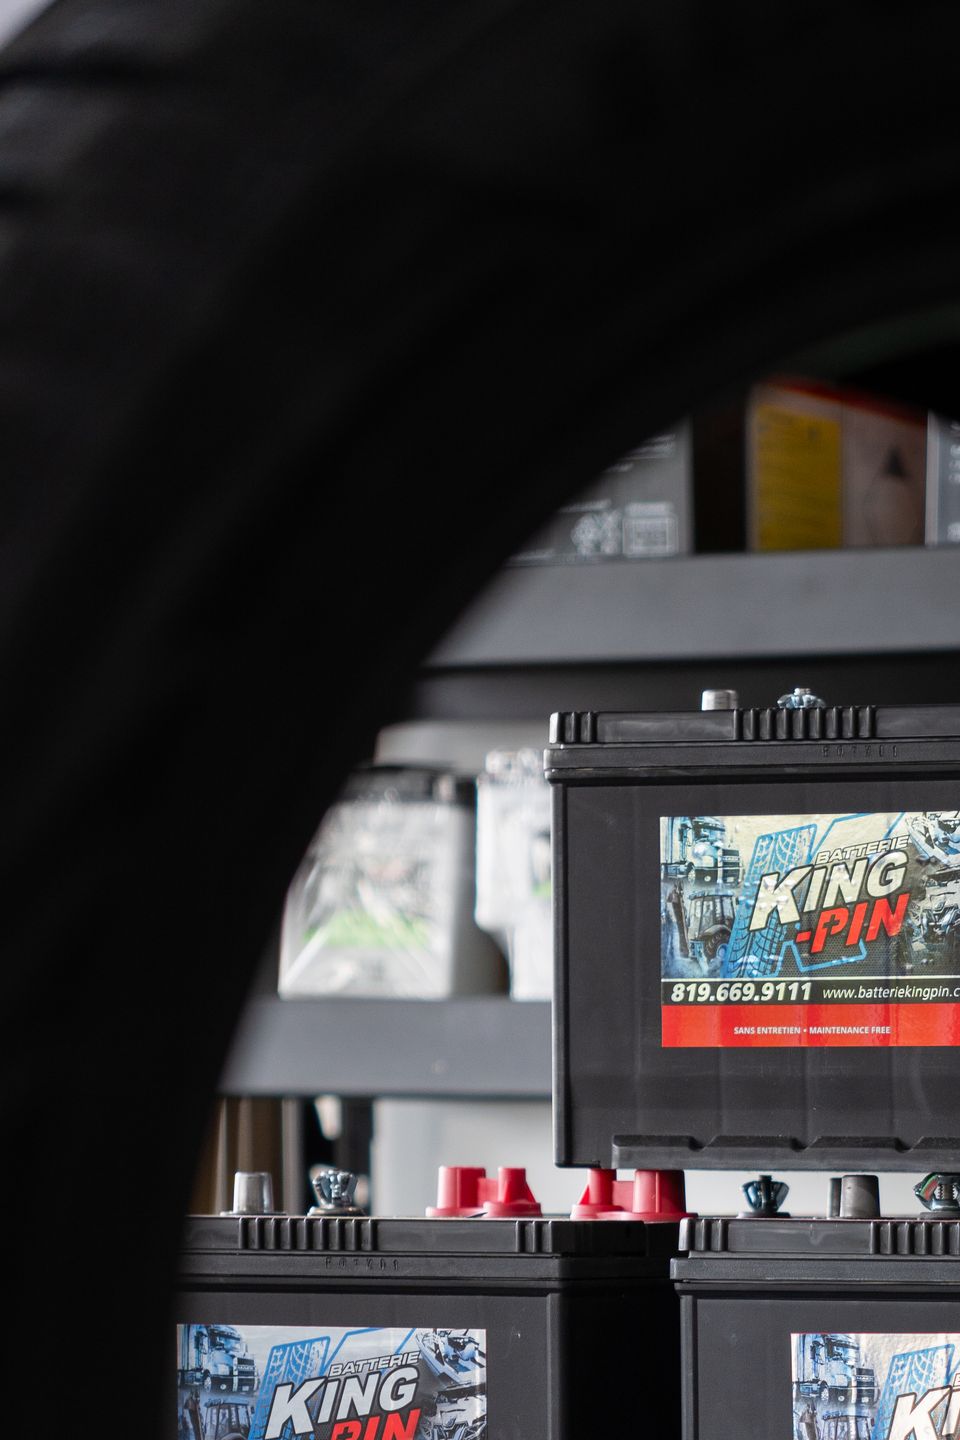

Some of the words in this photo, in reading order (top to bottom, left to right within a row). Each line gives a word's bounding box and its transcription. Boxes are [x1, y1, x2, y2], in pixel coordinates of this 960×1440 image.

[815, 835, 911, 865] BATTERIE
[749, 852, 909, 931] KING
[795, 893, 910, 953] -PIN
[671, 982, 812, 1002] 819.669.9111
[733, 1026, 755, 1035] SANS
[756, 1026, 801, 1035] ENTRETIEN
[809, 1026, 869, 1035] MAINTENANCE
[871, 1026, 891, 1035] FREE
[329, 1351, 420, 1377] BATTERIE
[264, 1368, 418, 1440] KING
